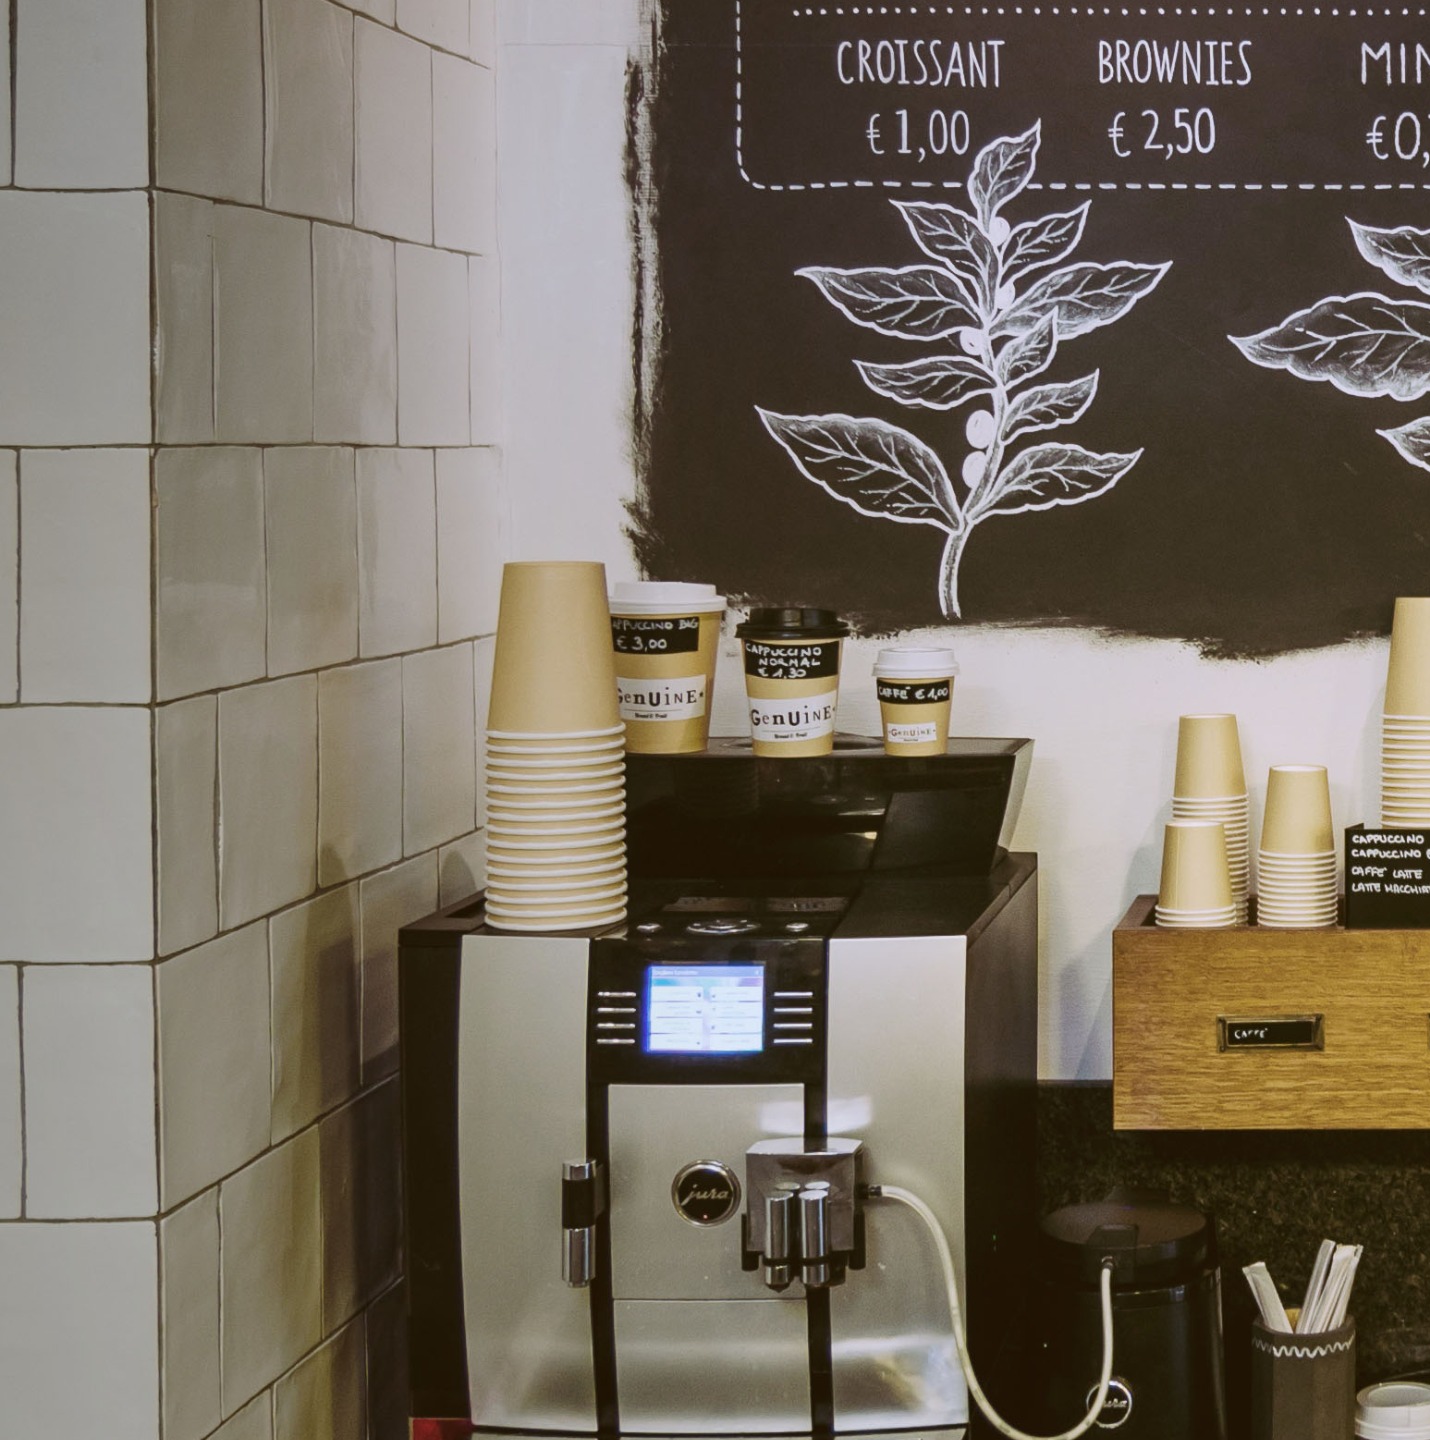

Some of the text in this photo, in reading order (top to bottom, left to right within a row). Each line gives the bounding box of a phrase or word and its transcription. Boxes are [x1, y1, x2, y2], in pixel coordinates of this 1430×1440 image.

[837, 39, 1006, 88] CROISSANT
[1098, 39, 1252, 86] BROWNIES
[678, 618, 699, 630] BIG
[745, 643, 822, 657] CAPPUCCINO
[758, 657, 821, 668] NORMAL
[1351, 833, 1425, 845] CAPPUCCINO
[1351, 848, 1422, 859] CAPPUCCINO
[1392, 868, 1424, 880] LATTE
[1351, 882, 1382, 893] LATTE
